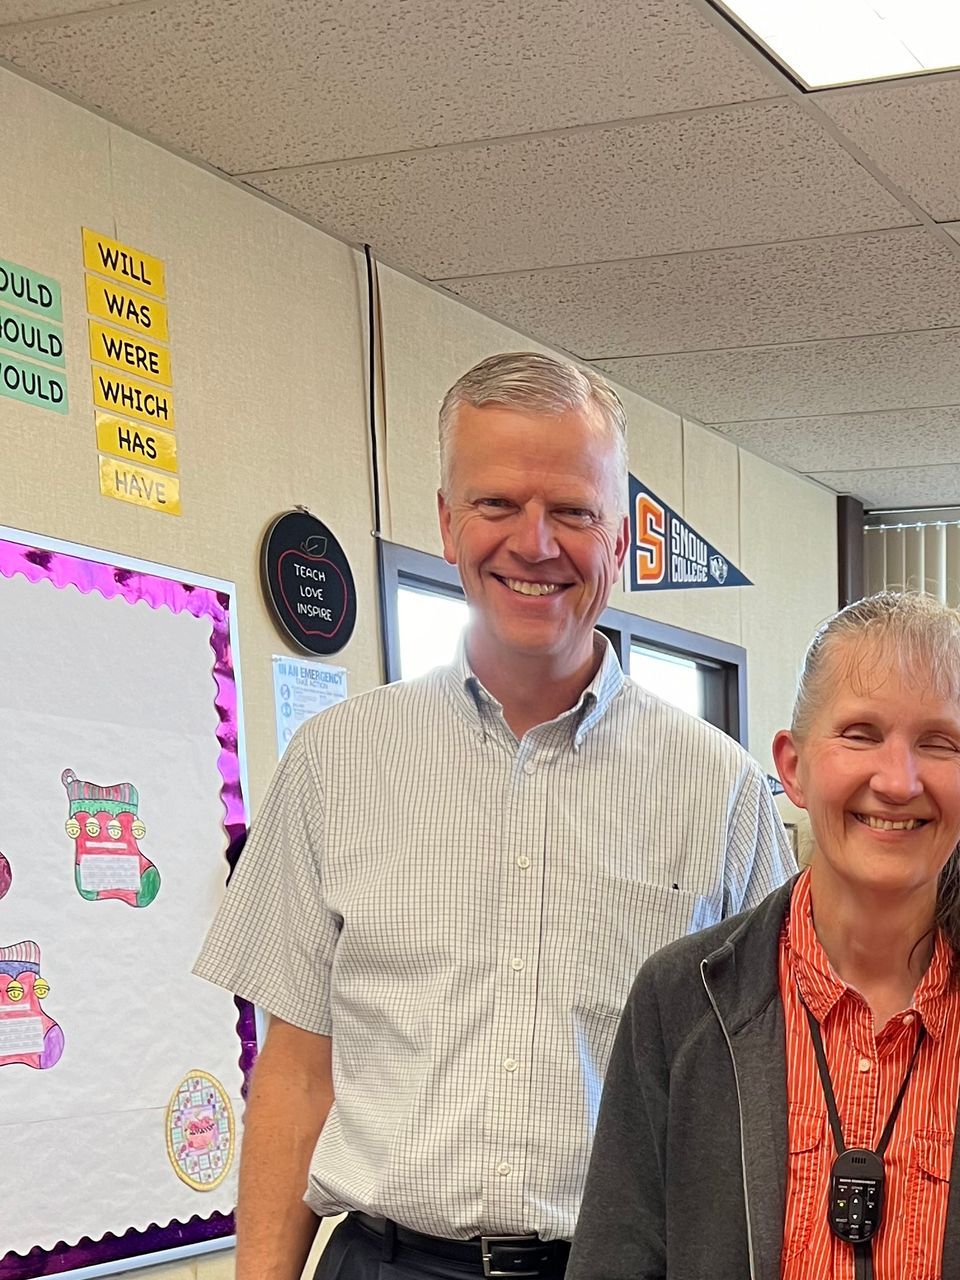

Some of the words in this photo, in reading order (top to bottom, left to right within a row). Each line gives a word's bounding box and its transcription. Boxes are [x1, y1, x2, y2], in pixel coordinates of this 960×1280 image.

[97, 241, 152, 286] WILL
[103, 288, 152, 329] WAS
[0, 316, 63, 358] OULD
[101, 332, 160, 374] WERE
[0, 363, 64, 403] OULD
[99, 375, 169, 421] WHICH
[117, 426, 158, 460] HAS
[114, 469, 167, 505] HAVE
[636, 492, 665, 584] S
[672, 518, 707, 566] SNOW
[293, 563, 326, 581] TEACH
[672, 555, 708, 582] COLLEGE
[297, 603, 332, 621] INSPIRE
[300, 585, 324, 601] LOVE
[288, 666, 300, 678] AN
[300, 667, 343, 685] EMERGENCY
